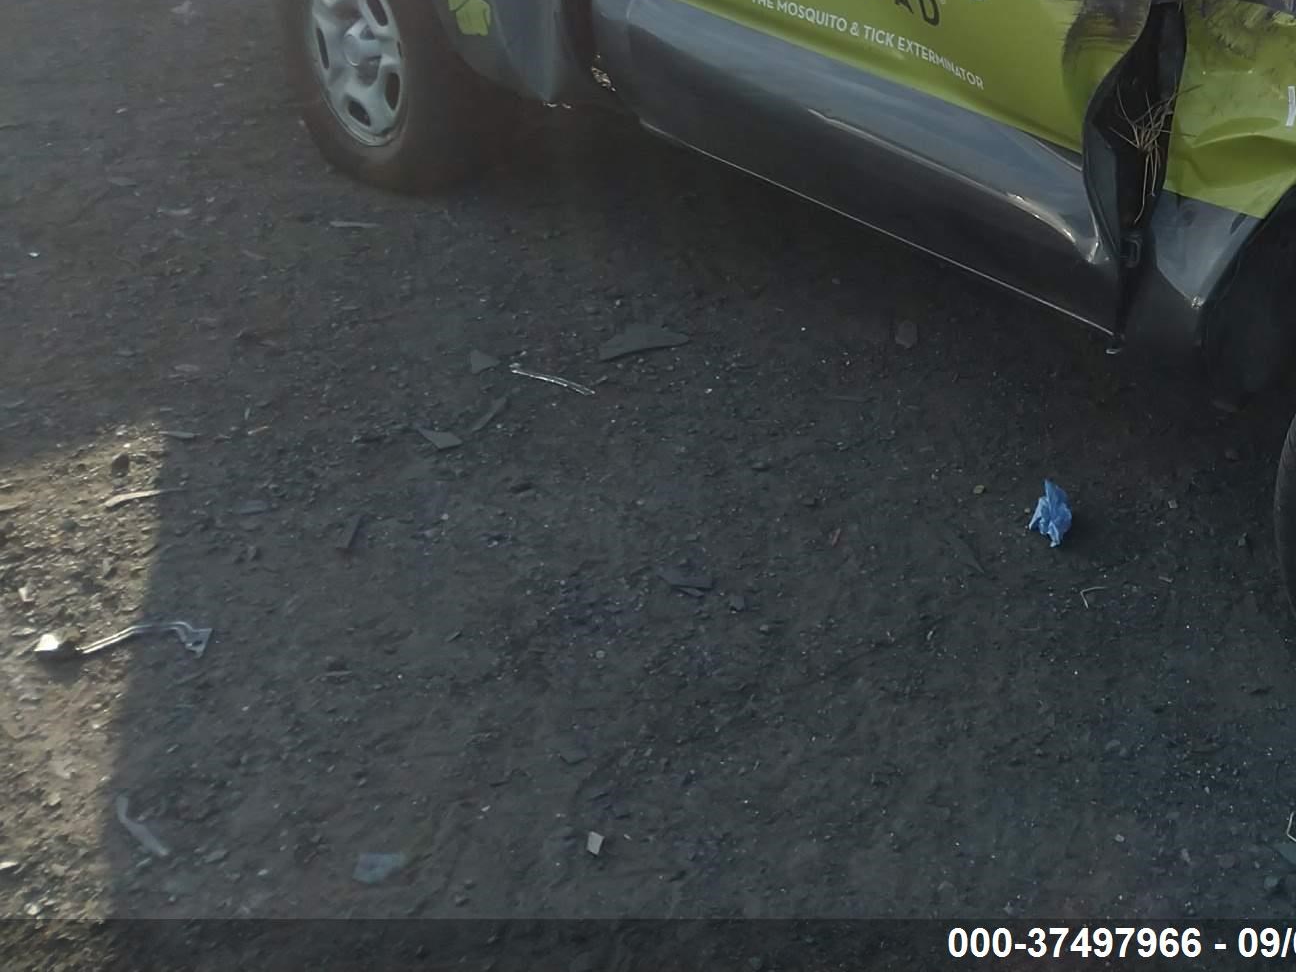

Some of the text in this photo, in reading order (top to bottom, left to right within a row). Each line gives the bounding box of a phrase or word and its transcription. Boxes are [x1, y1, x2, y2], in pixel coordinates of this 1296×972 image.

[850, 21, 860, 36] &
[863, 24, 896, 49] TICK
[896, 36, 986, 91] EXTERMINATOR
